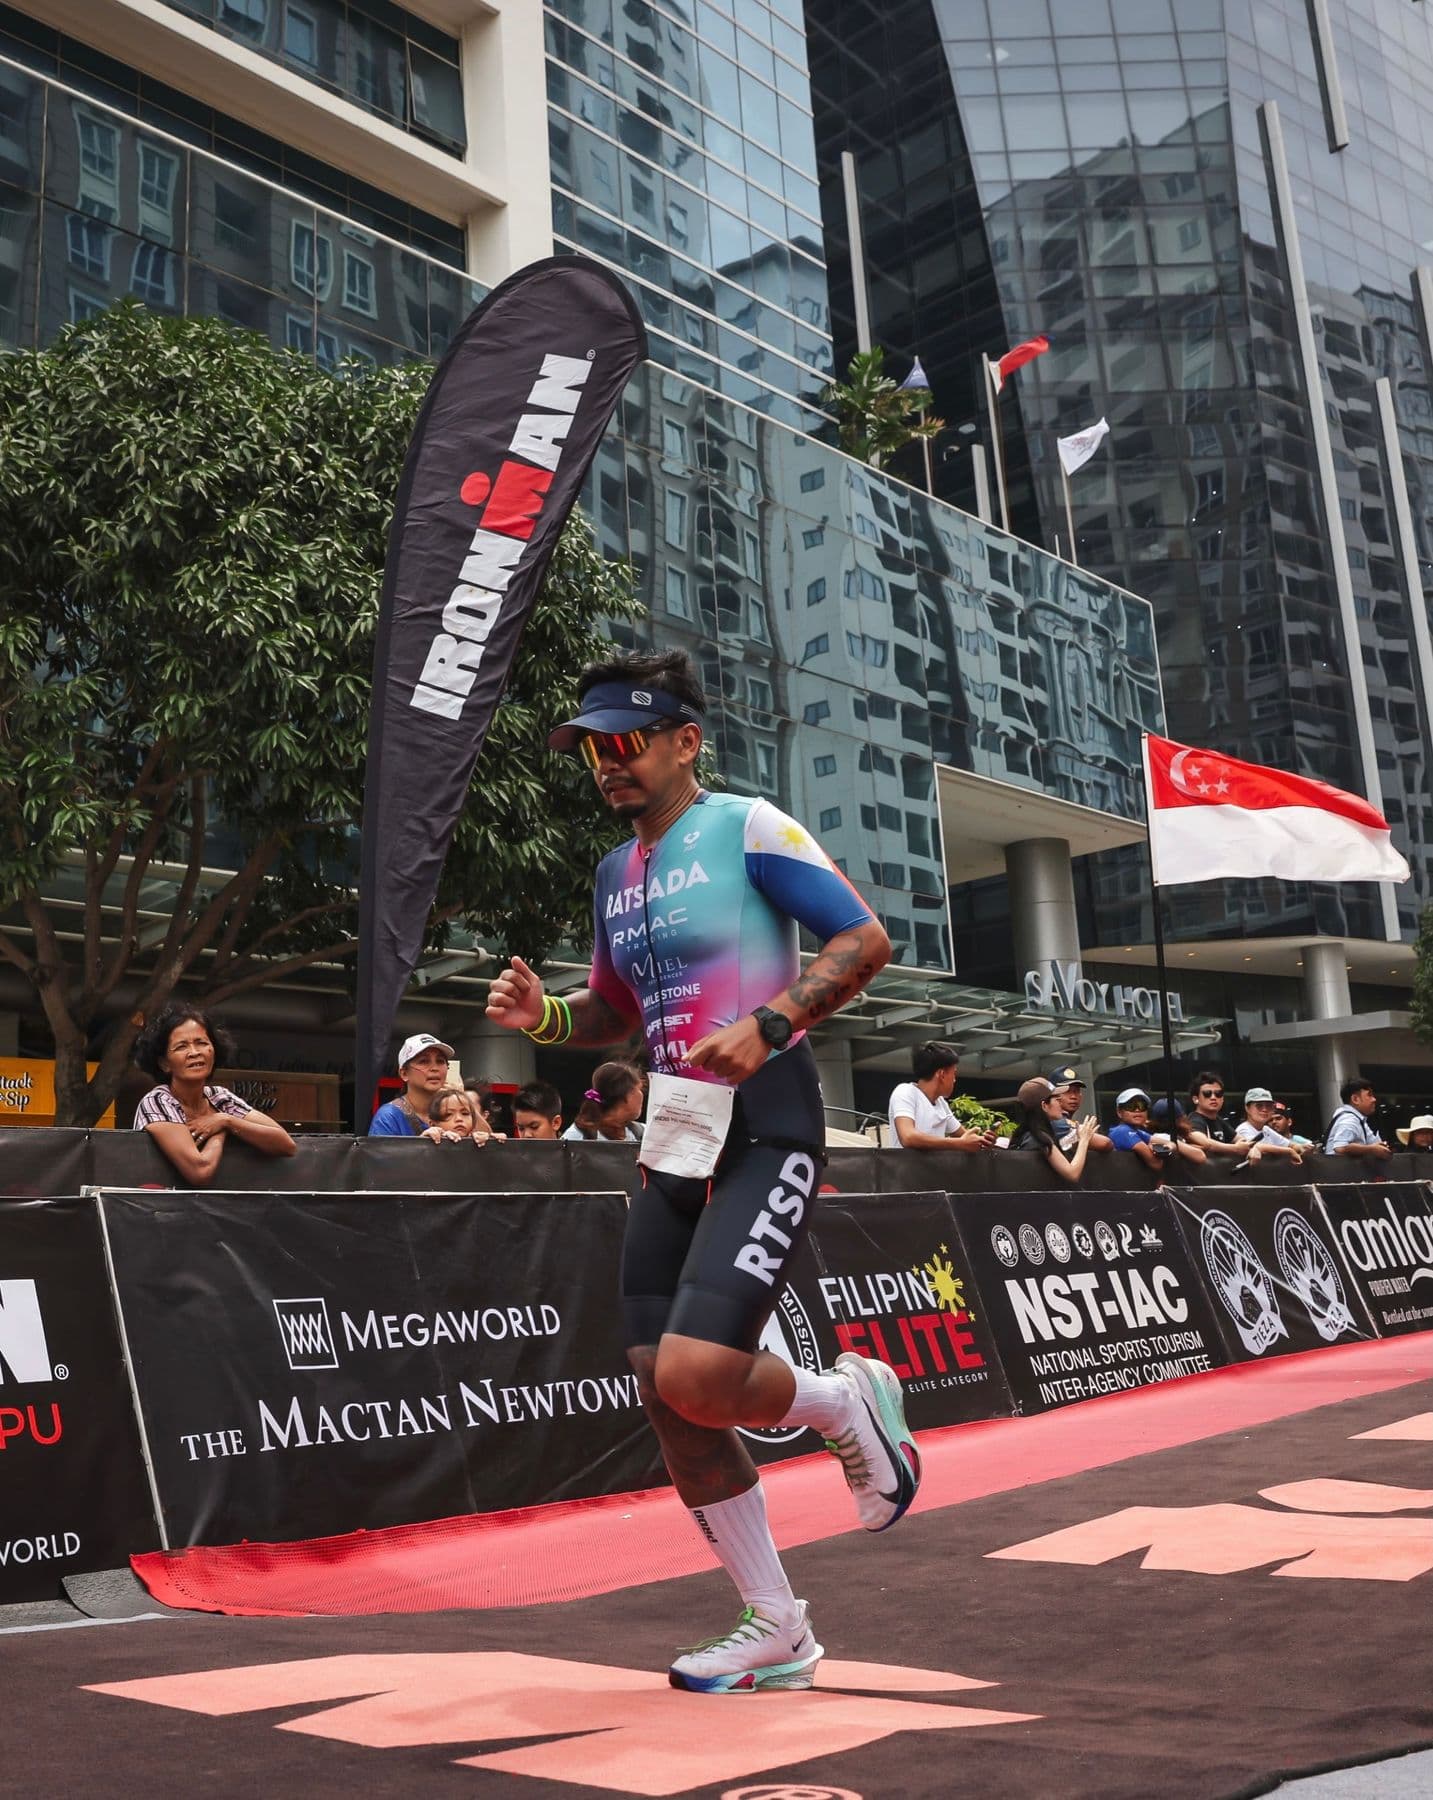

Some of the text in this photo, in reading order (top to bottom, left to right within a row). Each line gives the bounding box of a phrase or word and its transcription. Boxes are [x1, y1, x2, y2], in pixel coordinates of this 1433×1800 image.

[606, 861, 710, 919] RATSADA
[612, 907, 688, 948] RMAC
[643, 983, 701, 1009] MILESTONE
[1024, 960, 1189, 1024] SAVOY HOTEL
[646, 1013, 693, 1038] OFFSET
[6, 1091, 30, 1112] Sip
[733, 1152, 815, 1287] RTSD
[340, 1304, 561, 1352] MEGAWORLD
[1004, 1265, 1189, 1344] NST-IAC
[1029, 1330, 1204, 1377] NATIONAL SPORTS TOURISM
[1252, 1316, 1276, 1350] TIEZA
[908, 1371, 989, 1393] ELITE CATEGORY
[1039, 1354, 1213, 1404] INTER-AGENCY COMMITTEE
[180, 1429, 246, 1461] THE
[257, 1395, 452, 1453] MACTAN
[0, 1532, 81, 1567] ORLD
